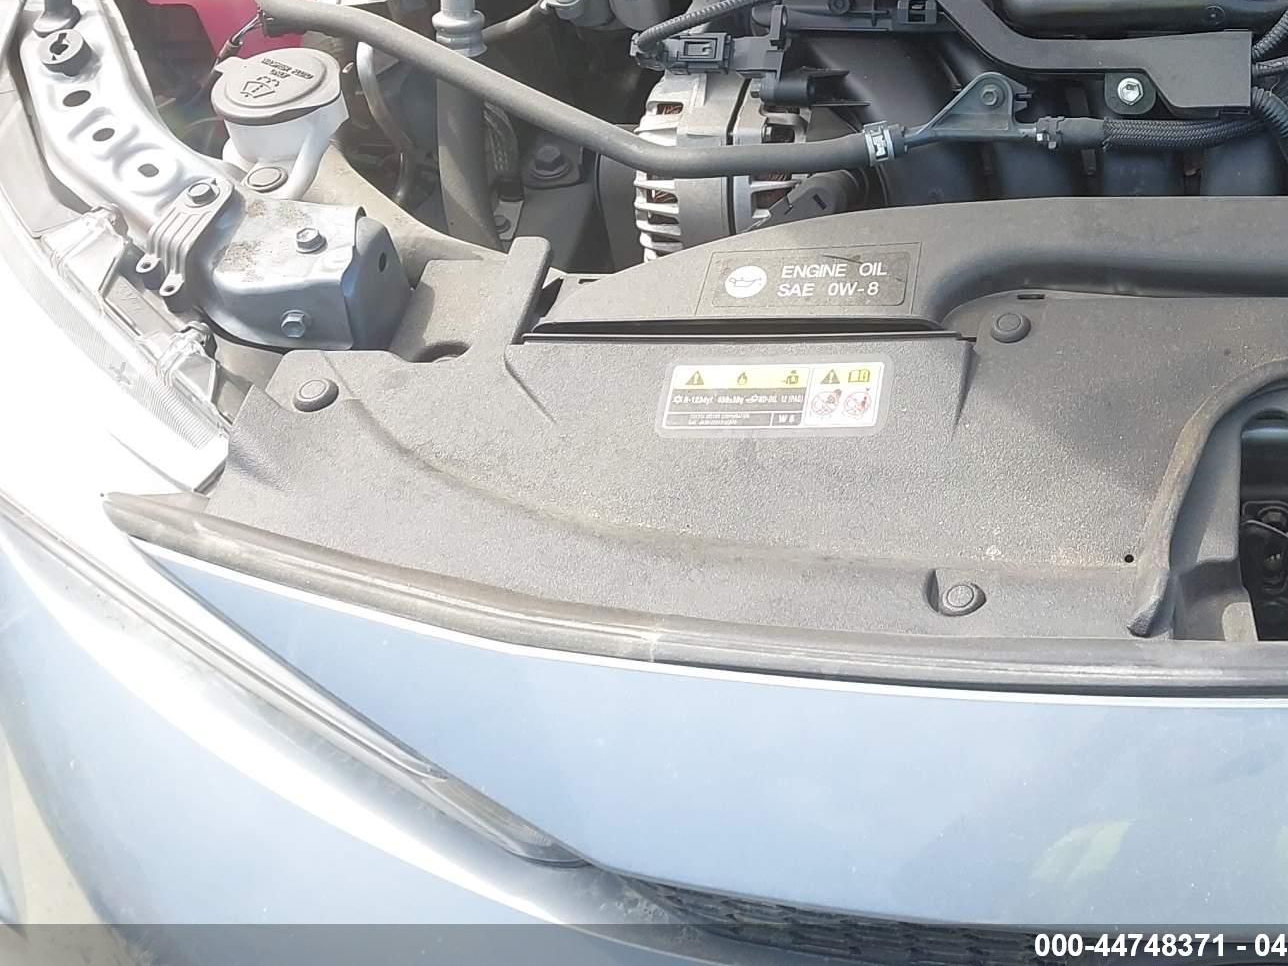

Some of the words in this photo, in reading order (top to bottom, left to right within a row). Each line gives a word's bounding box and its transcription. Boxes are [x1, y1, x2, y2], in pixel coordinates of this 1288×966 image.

[781, 263, 848, 279] ENGINE
[859, 261, 888, 277] OIL
[777, 282, 816, 297] SAE
[827, 281, 879, 297] 0W-8
